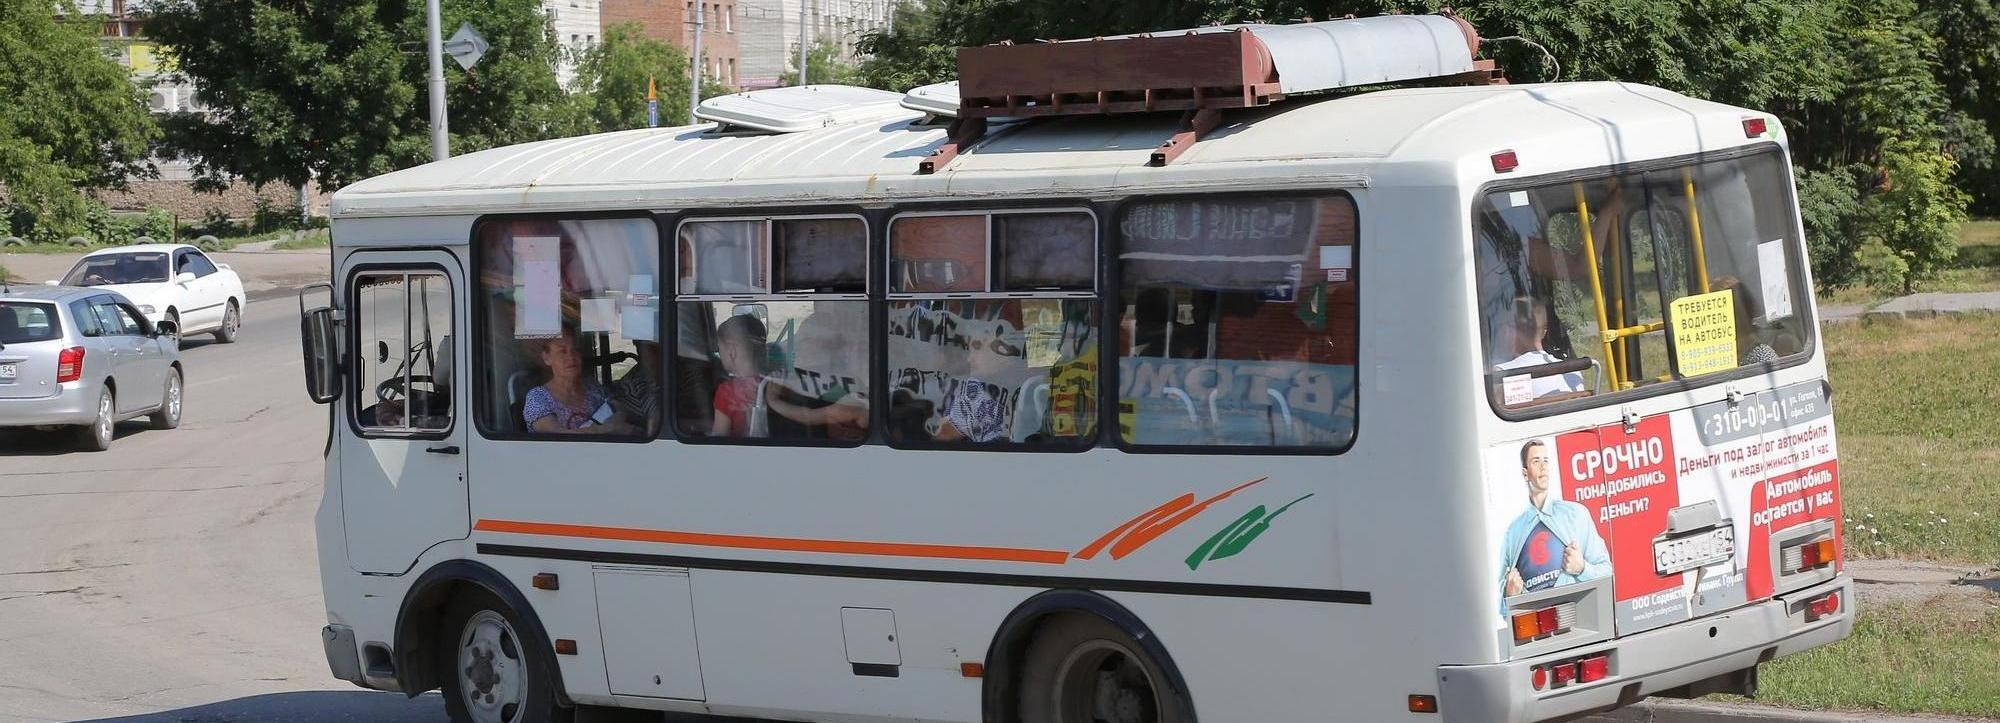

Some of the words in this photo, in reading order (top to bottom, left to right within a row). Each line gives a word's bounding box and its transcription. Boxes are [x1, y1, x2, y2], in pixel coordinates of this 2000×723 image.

[1678, 297, 1727, 314] ТРЕБУЕТСЯ
[1679, 334, 1691, 345] НА
[1695, 326, 1732, 343] АВТОБУС
[1682, 313, 1727, 330] ВОДИТЕЛЬ
[2, 365, 13, 374] 54
[1714, 400, 1788, 436] 310-00-01
[1571, 437, 1664, 481] СРОЧНО
[1680, 453, 1721, 477] Деньги
[1724, 447, 1744, 463] под
[1747, 440, 1774, 458] залог
[1778, 425, 1828, 451] автомобиля
[1731, 468, 1737, 479] и
[1739, 455, 1800, 477] недвижимости
[1801, 449, 1809, 460] за
[1817, 444, 1829, 455] час
[1575, 471, 1666, 501] ПОНАДОБИЛИСЬ
[1767, 469, 1832, 499] Автомобиль
[1600, 497, 1649, 523] ДЕНЬГИ?
[1753, 498, 1805, 526] остается
[1807, 496, 1814, 514] у
[1816, 490, 1834, 507] вас
[1632, 595, 1650, 610] ООО
